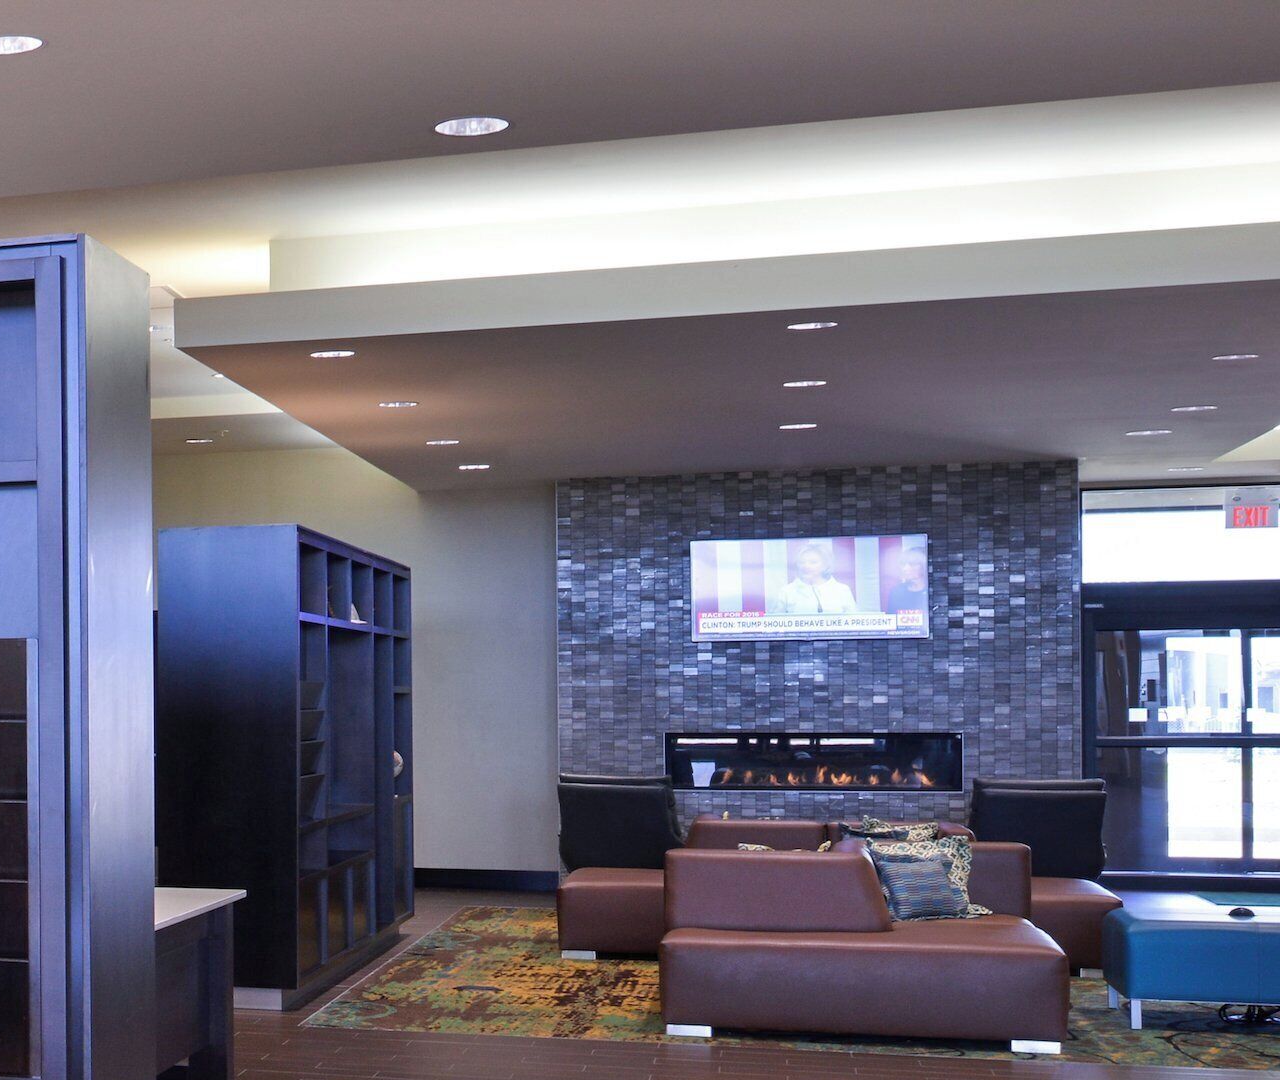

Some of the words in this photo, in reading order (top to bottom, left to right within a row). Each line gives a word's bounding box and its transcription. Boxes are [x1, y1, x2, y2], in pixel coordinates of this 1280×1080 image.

[1233, 506, 1269, 527] EXIT
[763, 620, 793, 628] SHOULD
[826, 619, 842, 627] LIKE
[851, 618, 892, 626] PRESIDENT
